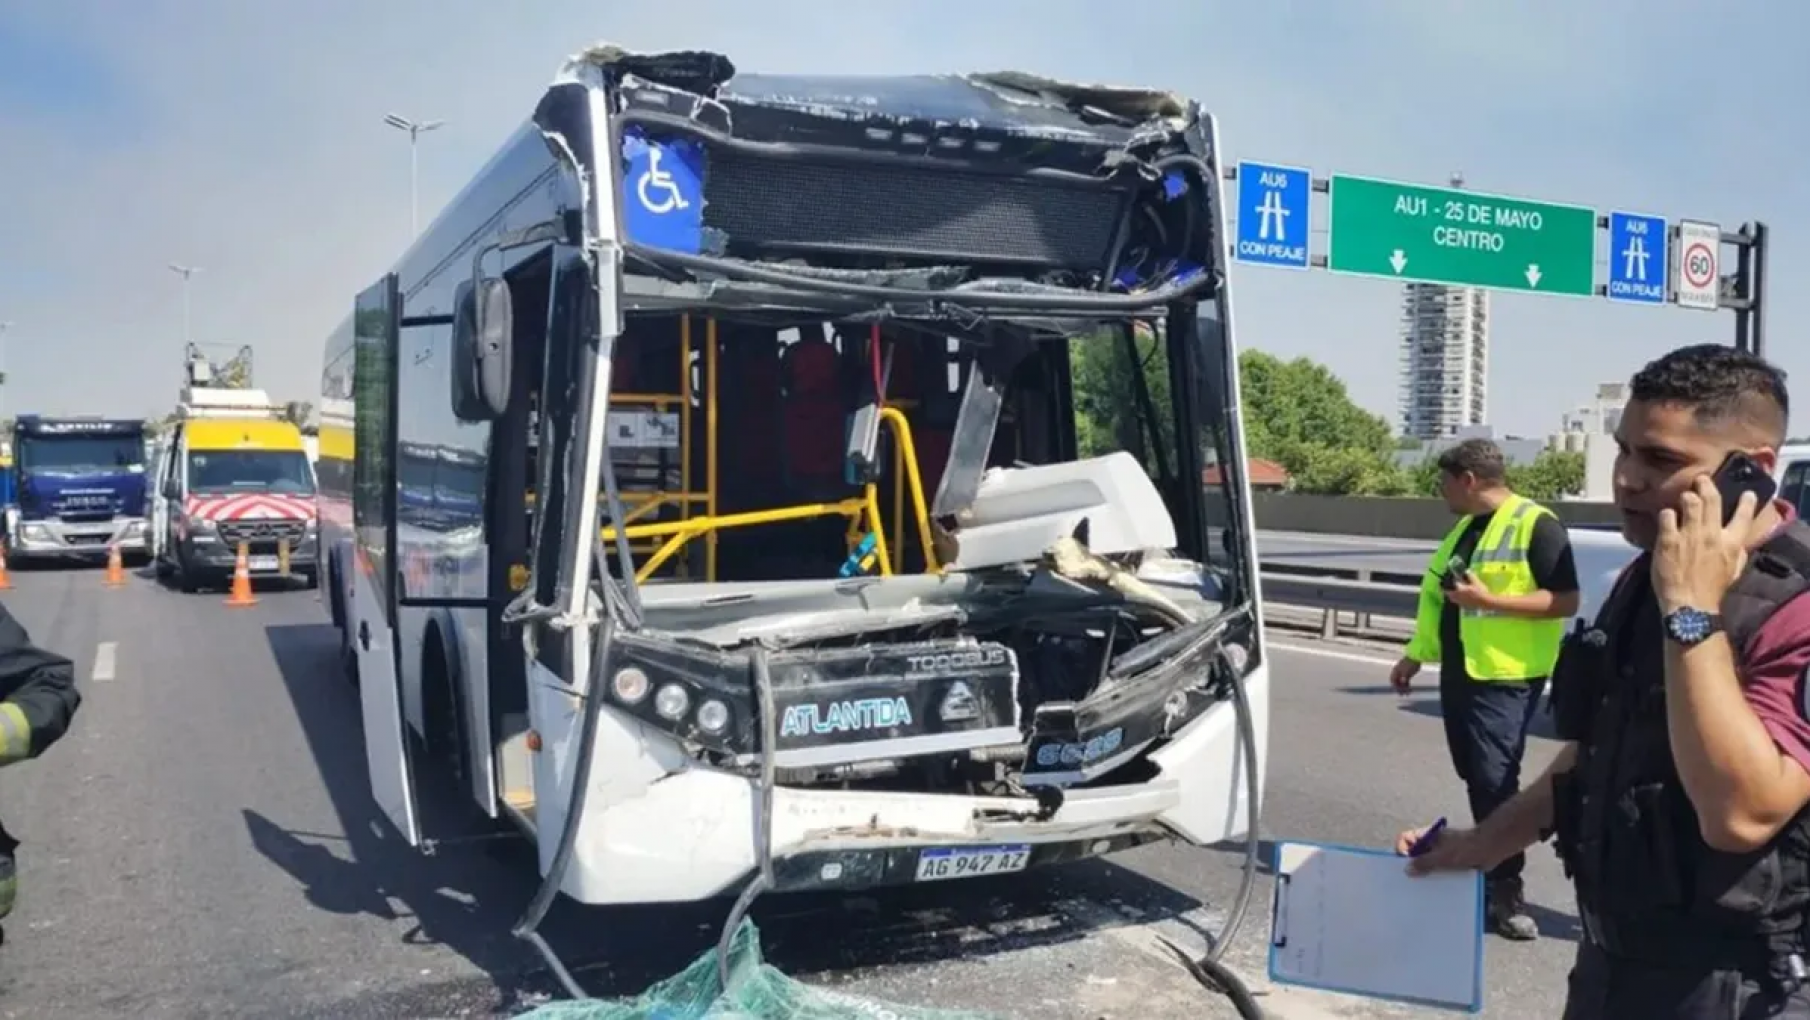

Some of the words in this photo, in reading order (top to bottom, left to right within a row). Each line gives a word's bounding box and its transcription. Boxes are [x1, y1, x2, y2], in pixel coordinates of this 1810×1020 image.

[1259, 171, 1288, 189] AU6
[1394, 195, 1428, 217] AU1
[1444, 201, 1464, 222] 25
[1468, 204, 1492, 225] DE
[1495, 208, 1543, 230] MAYO
[1433, 226, 1504, 252] CENTRO
[1240, 241, 1266, 256] CON
[1268, 245, 1305, 260] PEAJE
[1690, 255, 1709, 276] 60
[1611, 280, 1631, 294] CON
[906, 650, 1005, 672] TODOBUS
[781, 696, 912, 737] ATLANTIDA
[922, 857, 950, 878] AG
[955, 853, 994, 874] 947
[998, 851, 1026, 871] AZ
